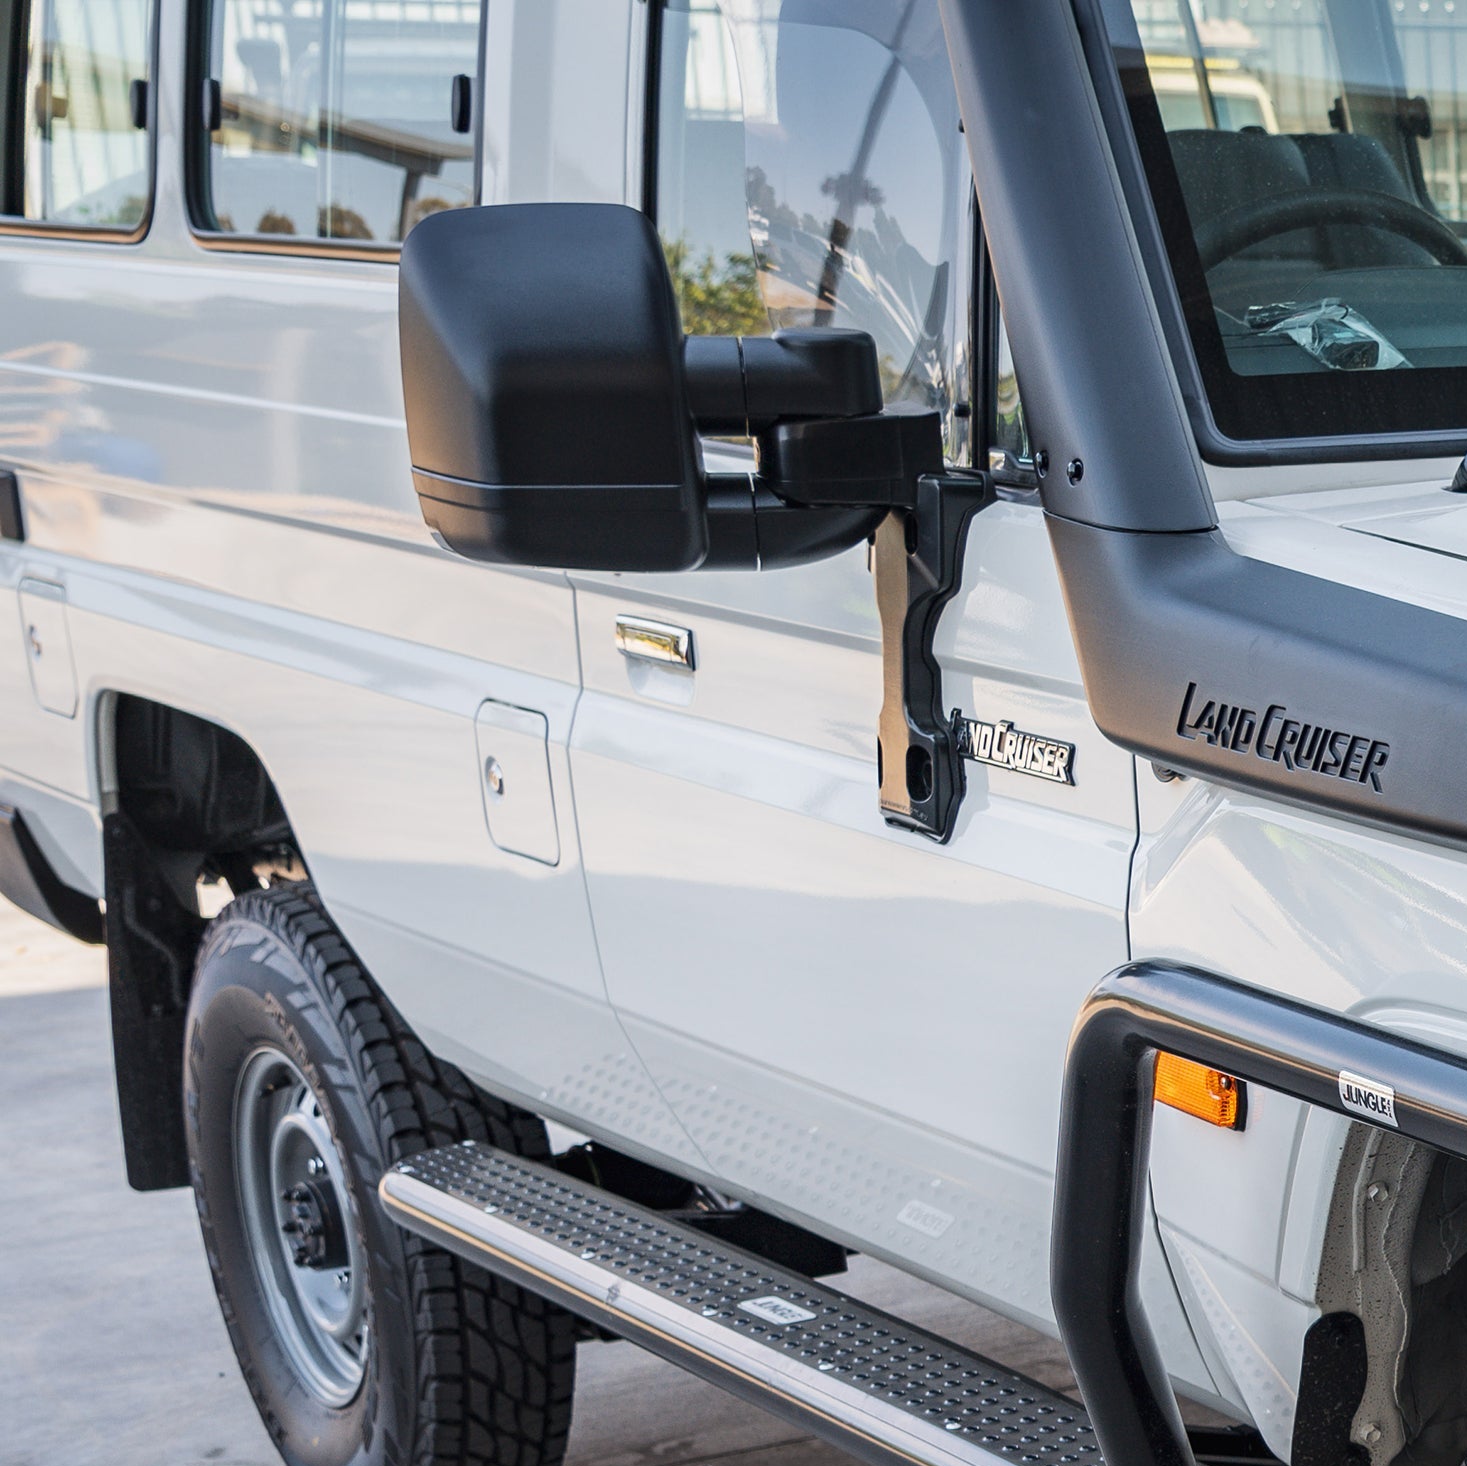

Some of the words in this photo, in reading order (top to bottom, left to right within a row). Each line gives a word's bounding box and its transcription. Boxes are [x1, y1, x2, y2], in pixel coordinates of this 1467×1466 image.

[992, 722, 1070, 782] CRUISER
[1176, 681, 1257, 754] LAND
[1256, 704, 1390, 794] CRUISER
[1342, 1084, 1388, 1116] JUNGLE
